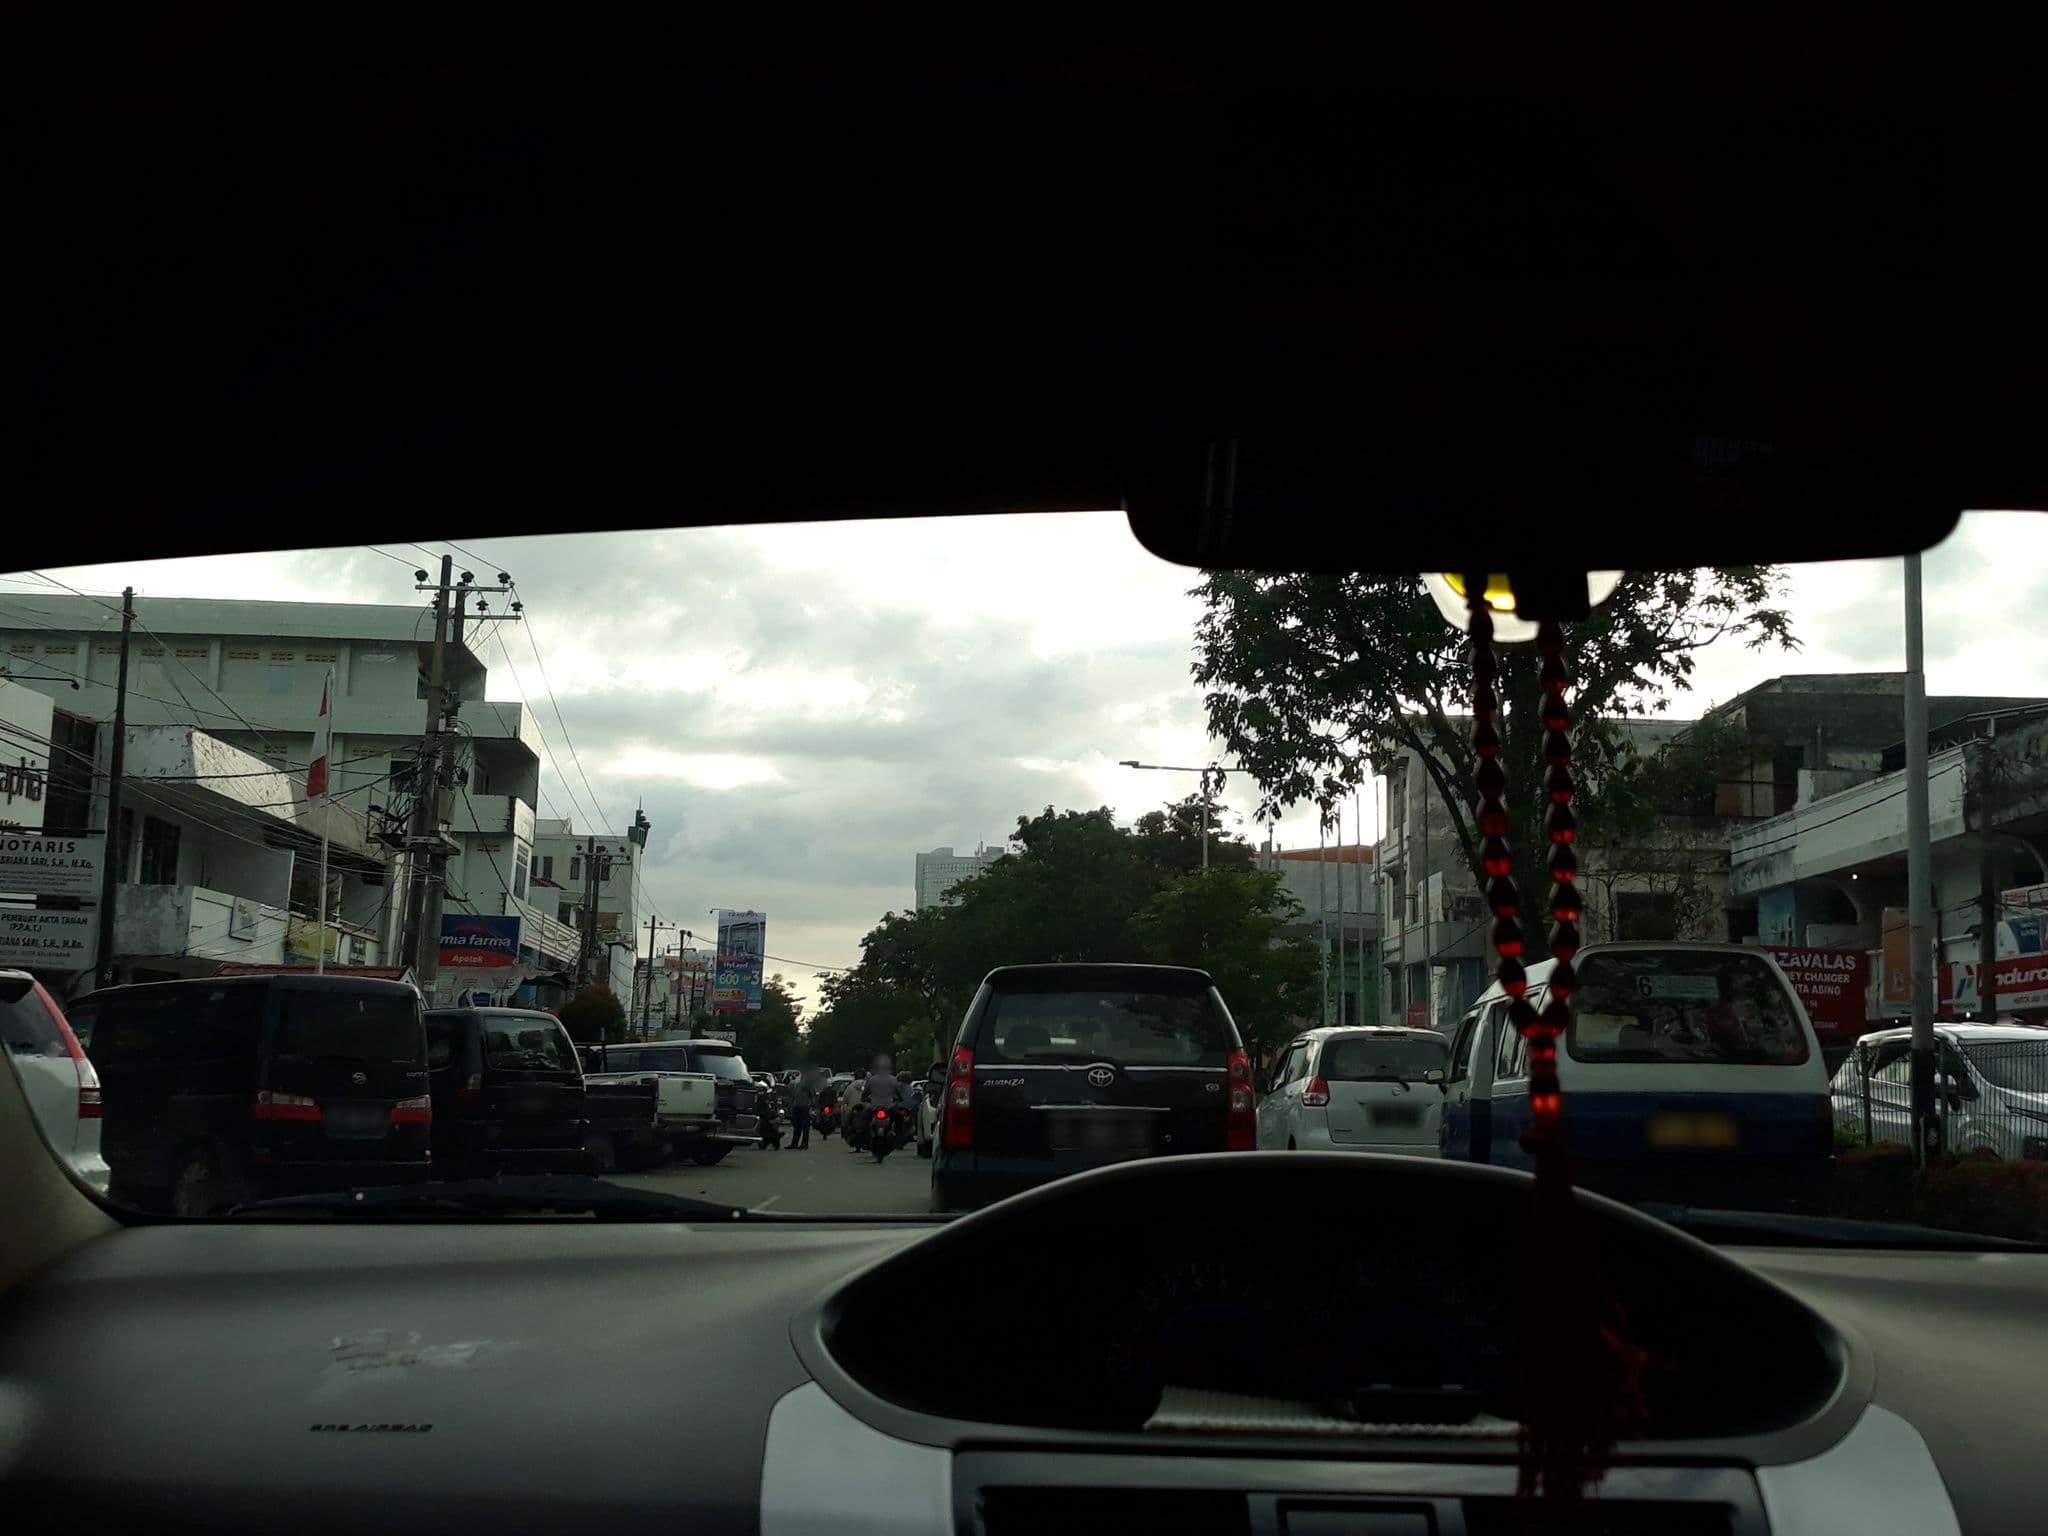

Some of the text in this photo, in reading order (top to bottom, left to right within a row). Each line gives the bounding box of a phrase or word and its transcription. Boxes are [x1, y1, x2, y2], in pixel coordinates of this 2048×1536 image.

[440, 933, 511, 947] mia farma
[452, 953, 484, 963] Apotek
[1790, 972, 1851, 984] EY CHANGER
[1979, 966, 2048, 988] nduro
[1638, 976, 1653, 997] 6
[982, 1078, 1025, 1087] AVANZA
